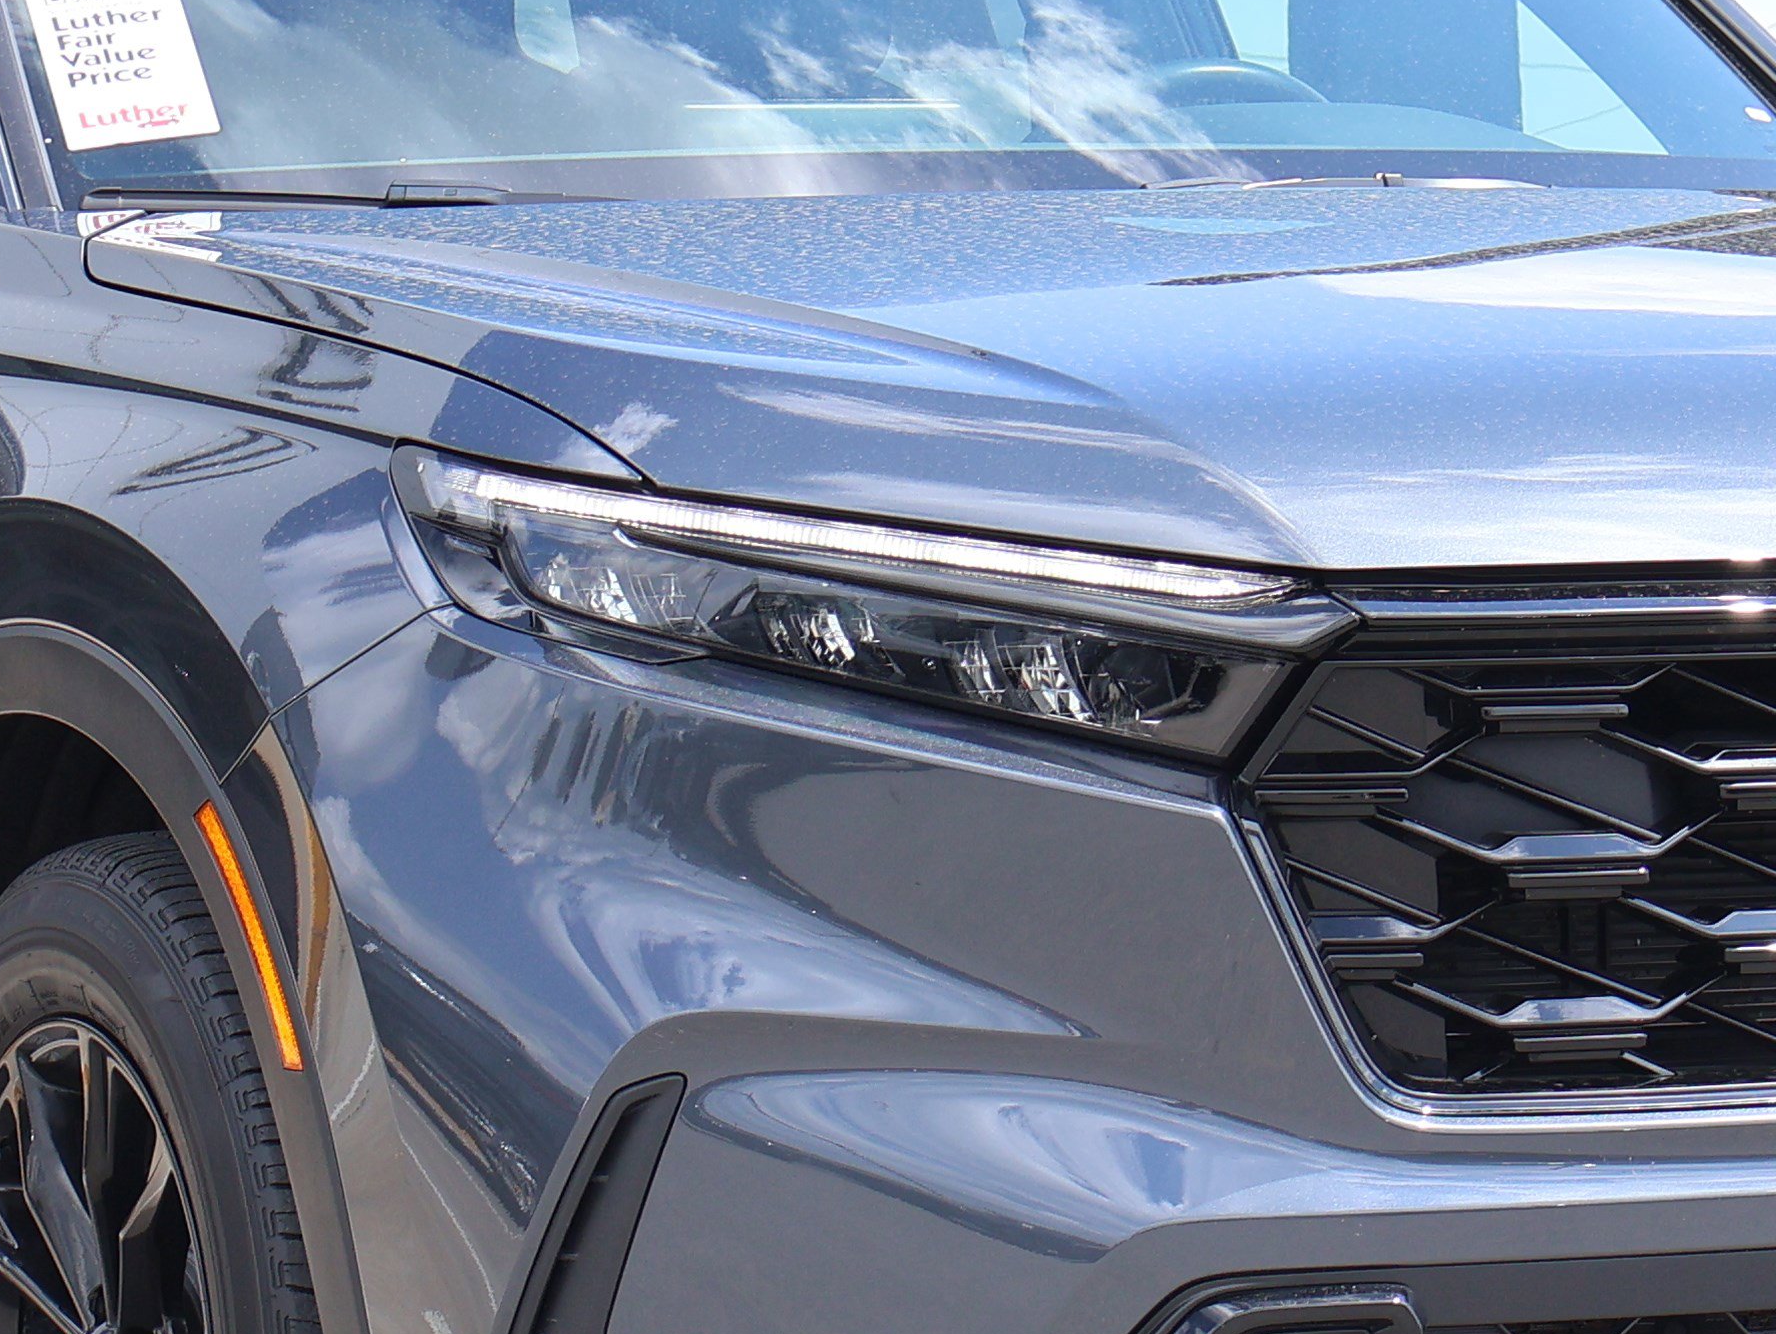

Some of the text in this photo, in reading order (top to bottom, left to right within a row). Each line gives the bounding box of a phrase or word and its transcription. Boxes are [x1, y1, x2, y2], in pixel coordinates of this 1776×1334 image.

[51, 9, 162, 32] Luther
[56, 29, 116, 51] Fair
[60, 47, 157, 67] Value
[67, 66, 153, 88] Price
[78, 103, 189, 129] Luther
